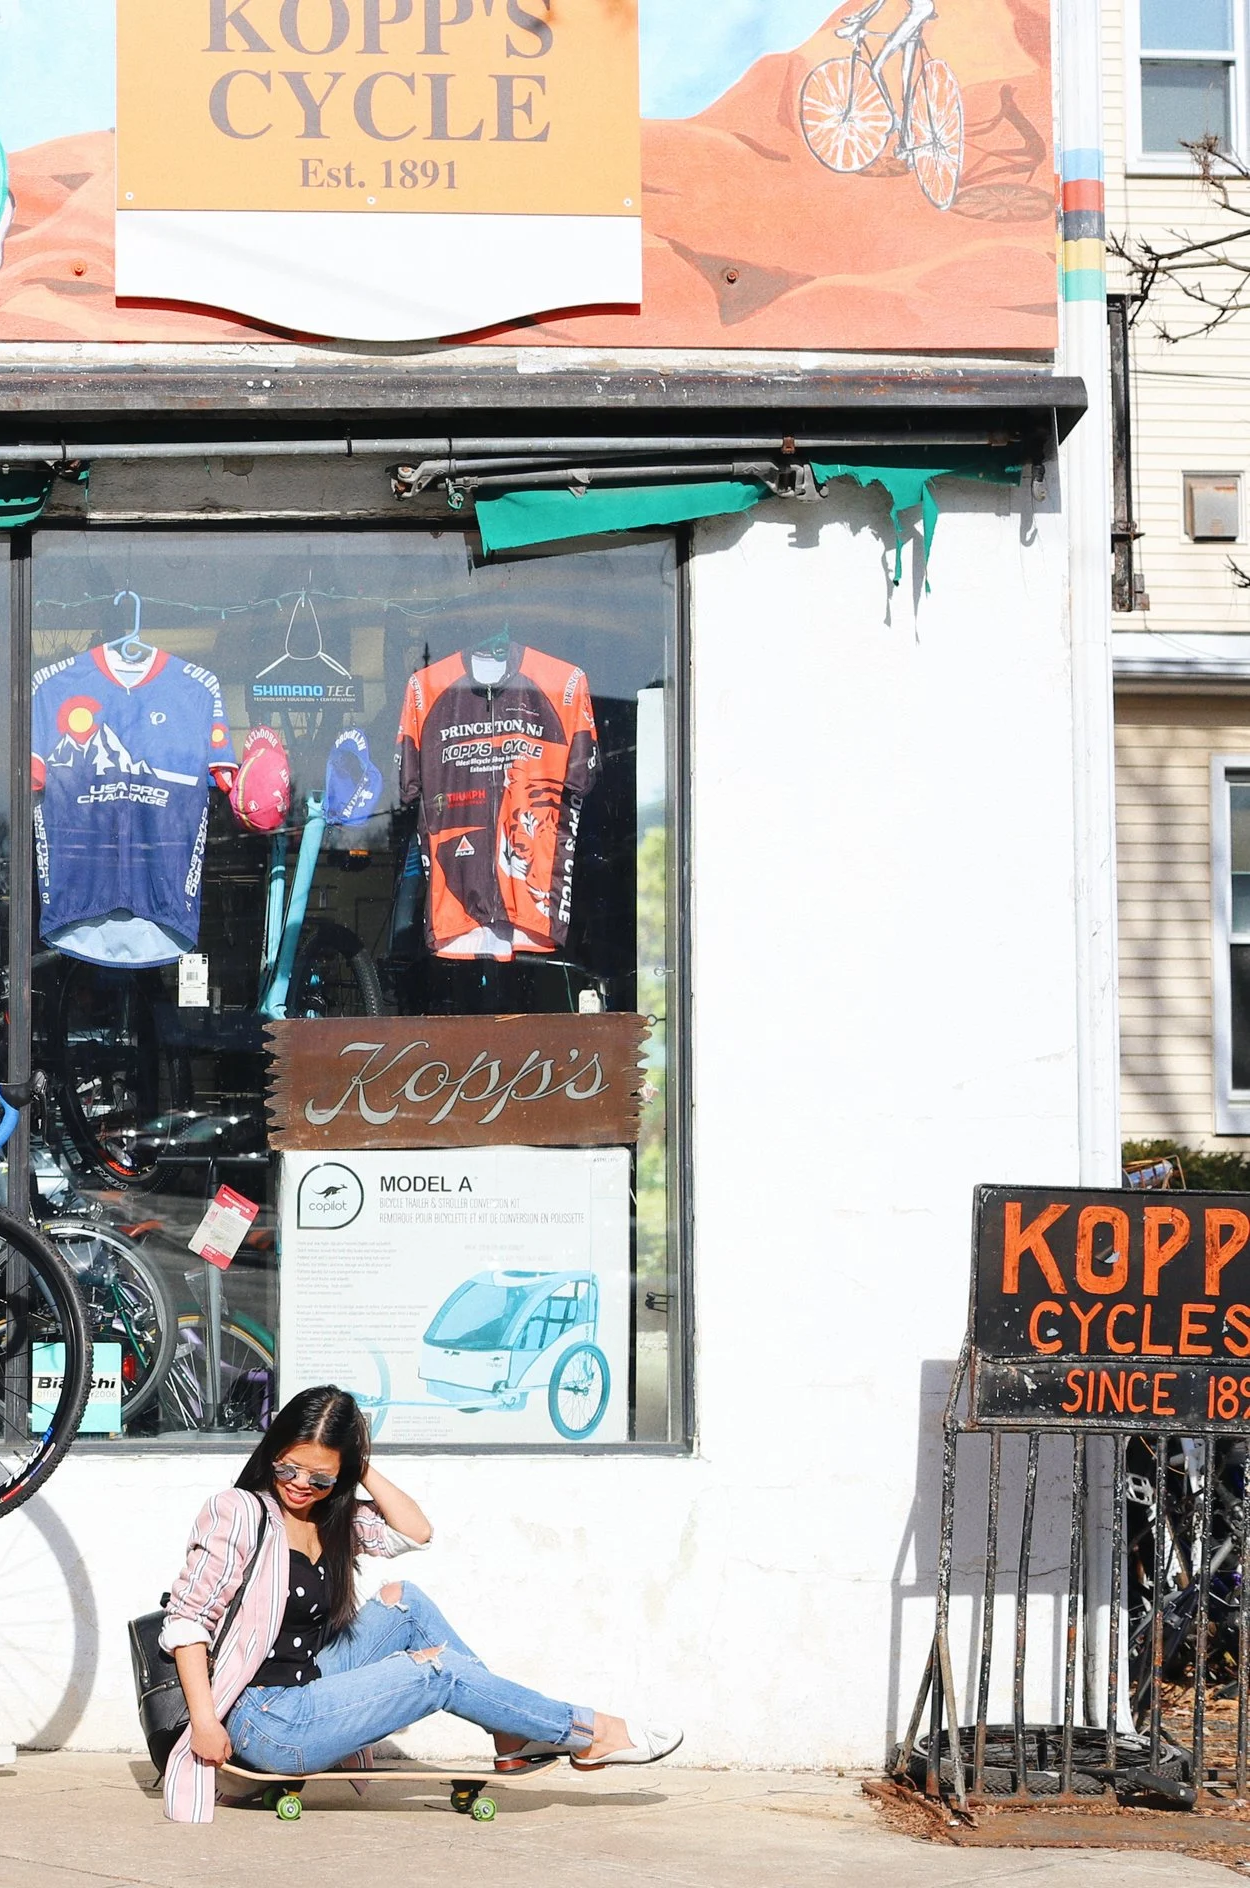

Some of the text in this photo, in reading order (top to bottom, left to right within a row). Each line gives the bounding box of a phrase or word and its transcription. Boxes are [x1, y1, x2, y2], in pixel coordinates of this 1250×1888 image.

[201, 0, 555, 59] KOPP'S
[208, 69, 551, 142] CYCLE
[298, 157, 460, 190] Est. 1891
[252, 684, 323, 697] SHIMANO
[526, 720, 544, 738] NJ
[441, 737, 543, 764] KOPP'S CYCLE
[89, 781, 170, 799] USA PRO
[76, 793, 169, 808] CHALLENGE
[303, 1040, 610, 1126] Kopp's
[379, 1175, 473, 1193] MODEL A
[308, 1199, 348, 1214] copilot
[379, 1197, 404, 1209] BICYCLE
[405, 1197, 430, 1209] TRAILER
[430, 1197, 437, 1209] &
[438, 1197, 468, 1209] STROLLER
[510, 1197, 520, 1209] KIT
[379, 1213, 585, 1225] REMORQUE POUR BICYCLETTE ET KIT DE CONVERSION EN POUSSETTE
[1027, 1300, 1250, 1358] CYCLES
[1061, 1368, 1178, 1416] SINCE
